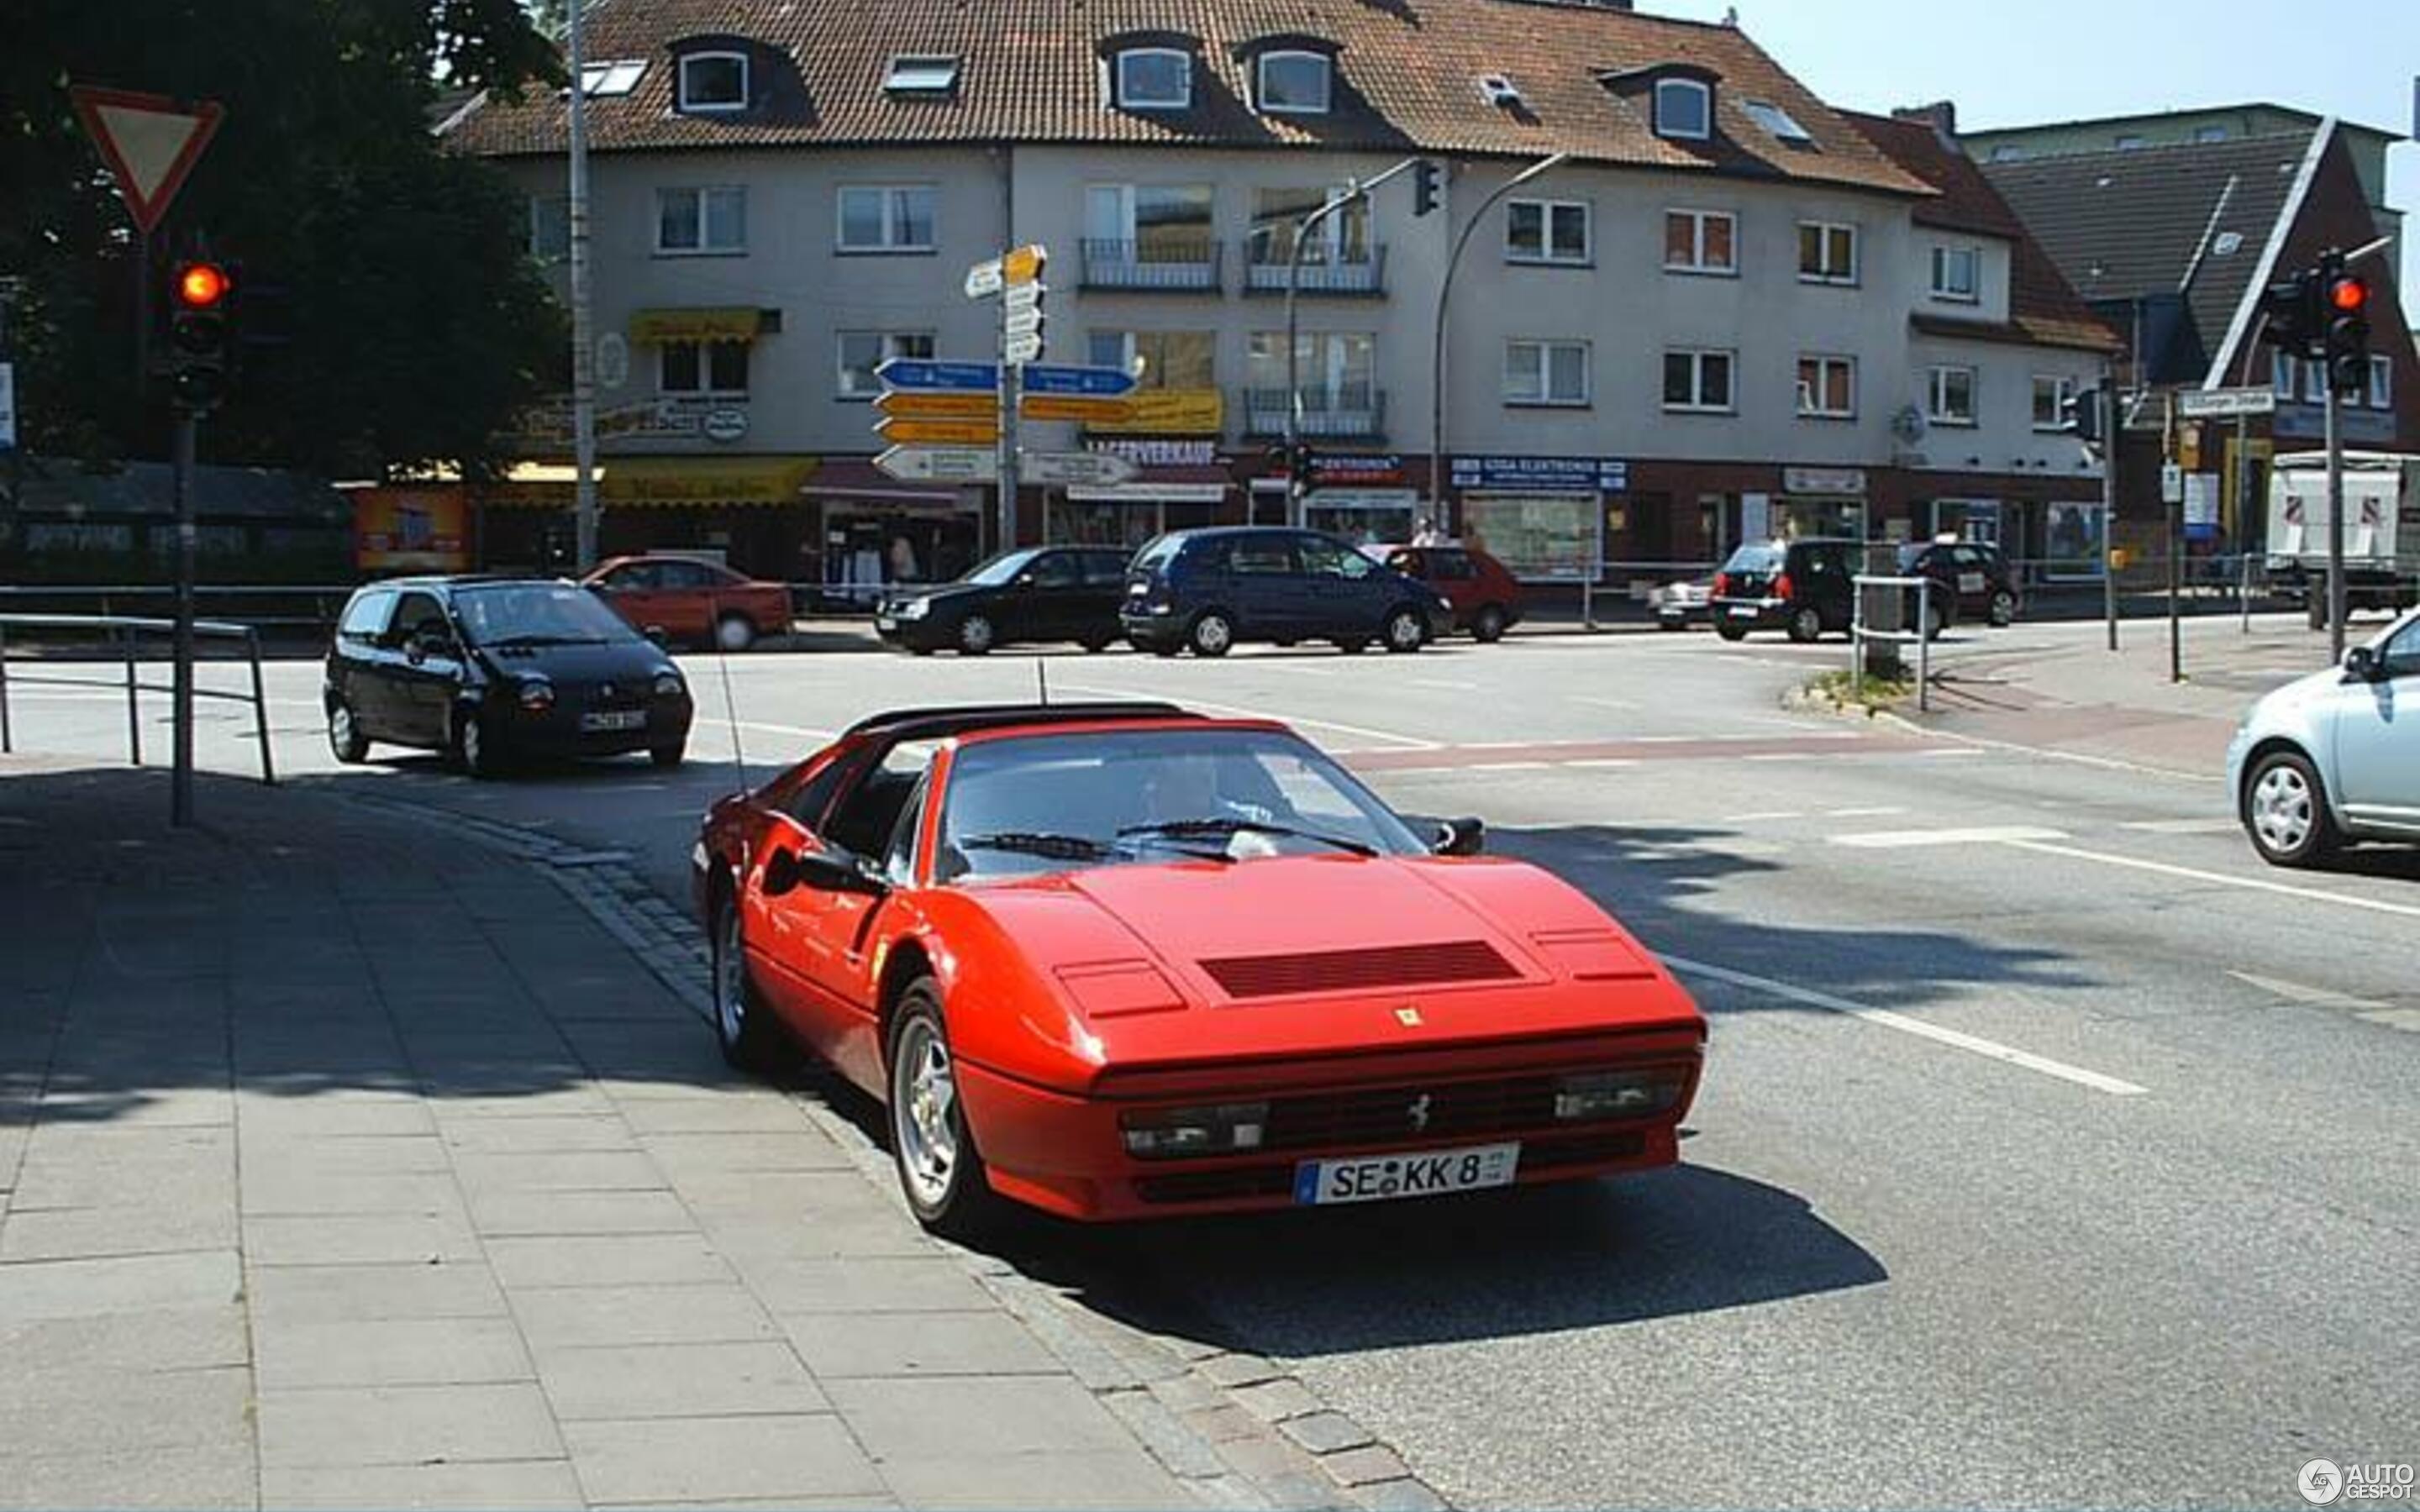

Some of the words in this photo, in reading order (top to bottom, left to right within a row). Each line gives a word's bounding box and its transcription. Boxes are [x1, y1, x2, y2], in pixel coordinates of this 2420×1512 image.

[1331, 1163, 1380, 1198] SE
[1402, 1156, 1453, 1192] KK
[1458, 1153, 1481, 1185] 8
